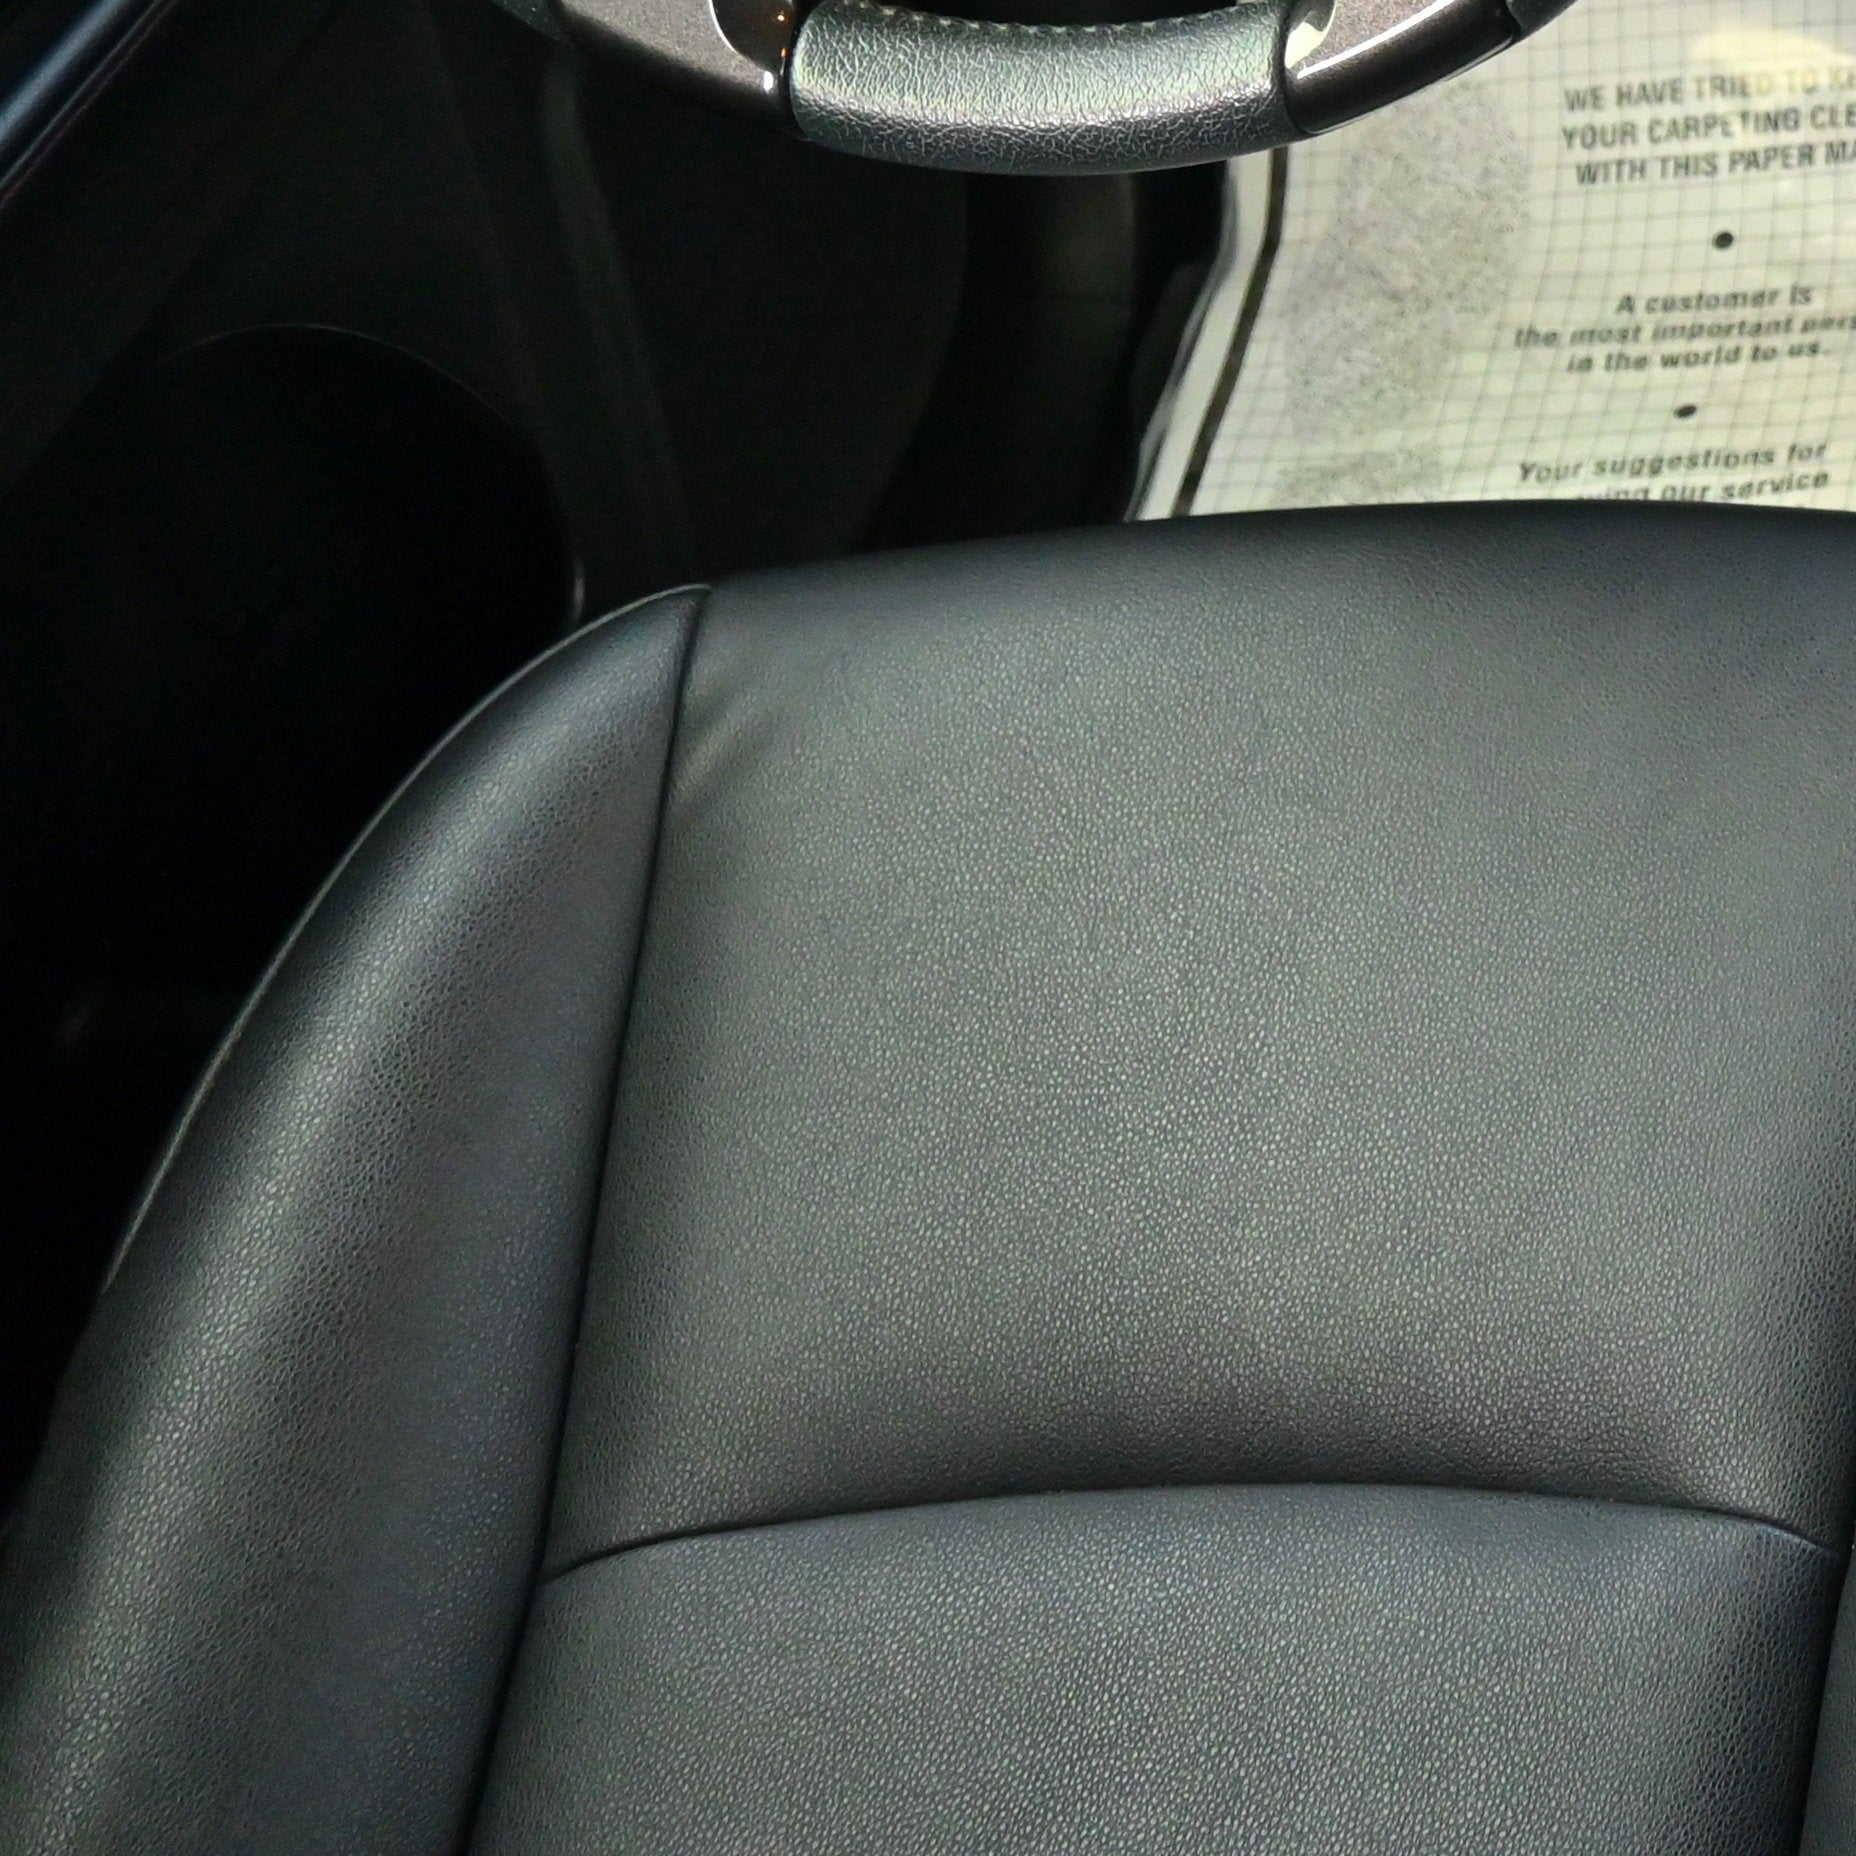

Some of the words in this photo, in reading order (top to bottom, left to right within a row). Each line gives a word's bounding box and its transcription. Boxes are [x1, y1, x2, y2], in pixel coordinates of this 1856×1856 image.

[1564, 86, 1606, 112] WE
[1615, 77, 1684, 107] HAVE
[1696, 70, 1773, 100] TRIED
[1786, 67, 1820, 94] TO
[1562, 123, 1637, 151] YOUR
[1647, 108, 1801, 144] CARPETING
[1576, 158, 1647, 187] WITH
[1659, 151, 1719, 180] THIS
[1729, 144, 1814, 174] PAPER
[1615, 294, 1636, 315] A
[1645, 287, 1779, 313] customer
[1515, 327, 1558, 348] the
[1569, 323, 1642, 344] most
[1652, 316, 1792, 345] important
[1604, 351, 1648, 373] the
[1660, 345, 1740, 370] world
[1751, 344, 1777, 363] to
[1518, 459, 1583, 483] Your
[1593, 446, 1775, 479] suggestions
[1787, 442, 1827, 464] for
[1661, 480, 1711, 501] our
[1721, 470, 1829, 500] service
